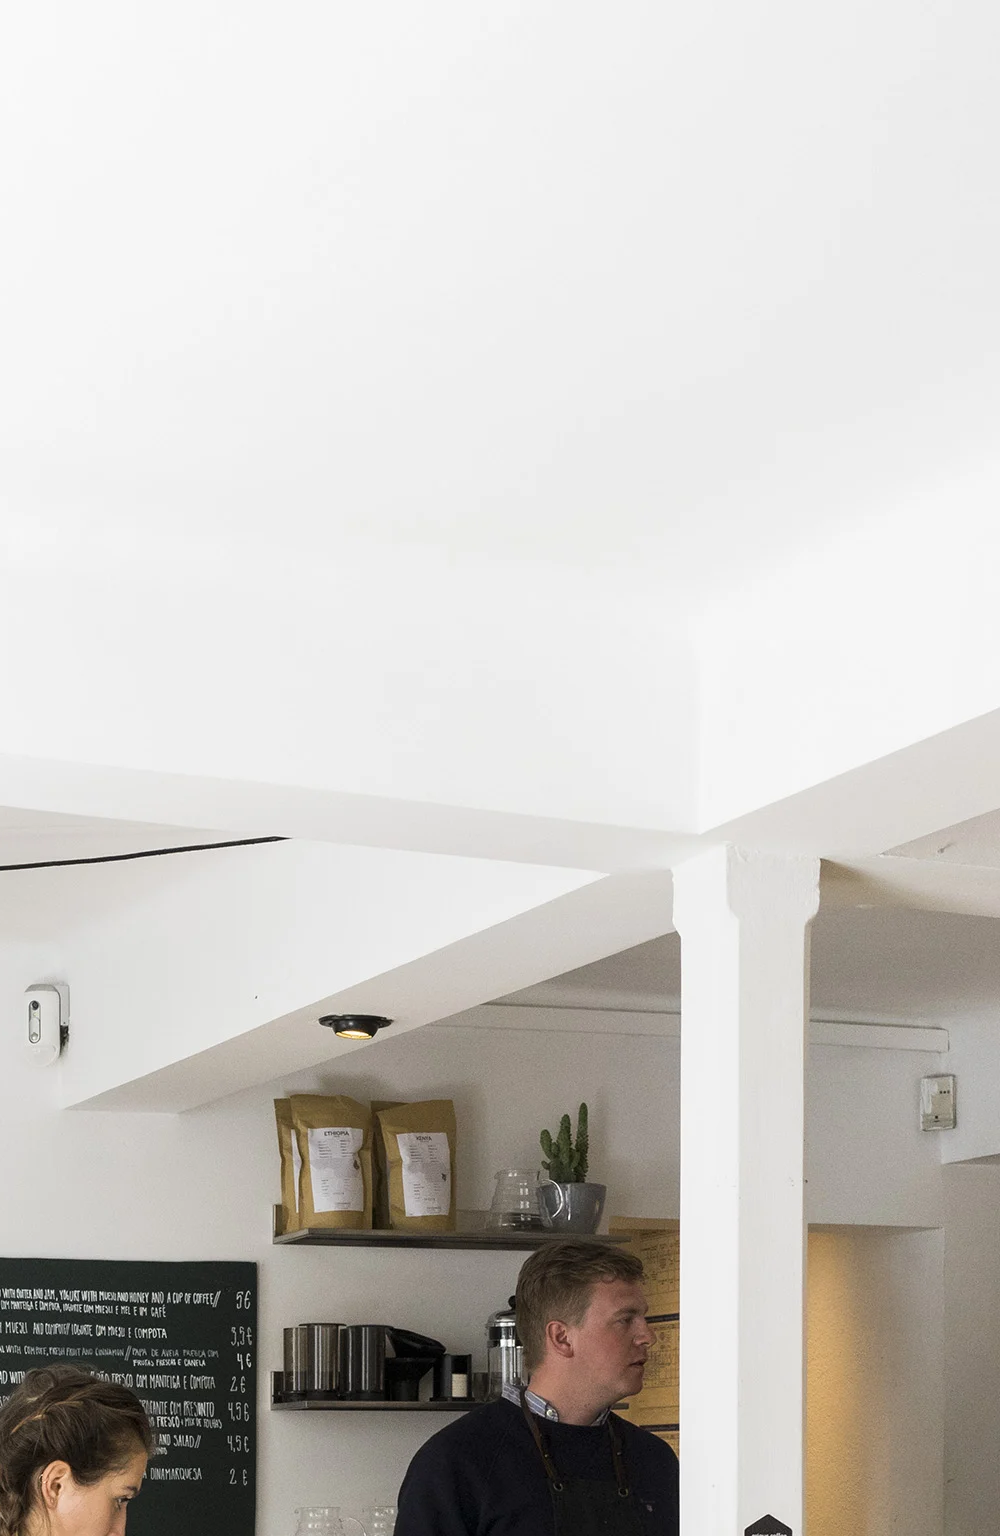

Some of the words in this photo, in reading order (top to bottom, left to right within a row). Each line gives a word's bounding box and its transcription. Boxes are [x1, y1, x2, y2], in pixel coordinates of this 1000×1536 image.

[81, 1291, 97, 1301] WITH
[152, 1292, 164, 1303] AND
[167, 1292, 171, 1303] A
[128, 1328, 131, 1338] E
[135, 1328, 167, 1338] COMPOTA
[136, 1374, 147, 1388] COM
[184, 1376, 186, 1389] E
[190, 1375, 215, 1389] COMPOTA
[174, 1435, 194, 1447] SALAD
[151, 1468, 202, 1480] DINAMARQUESA
